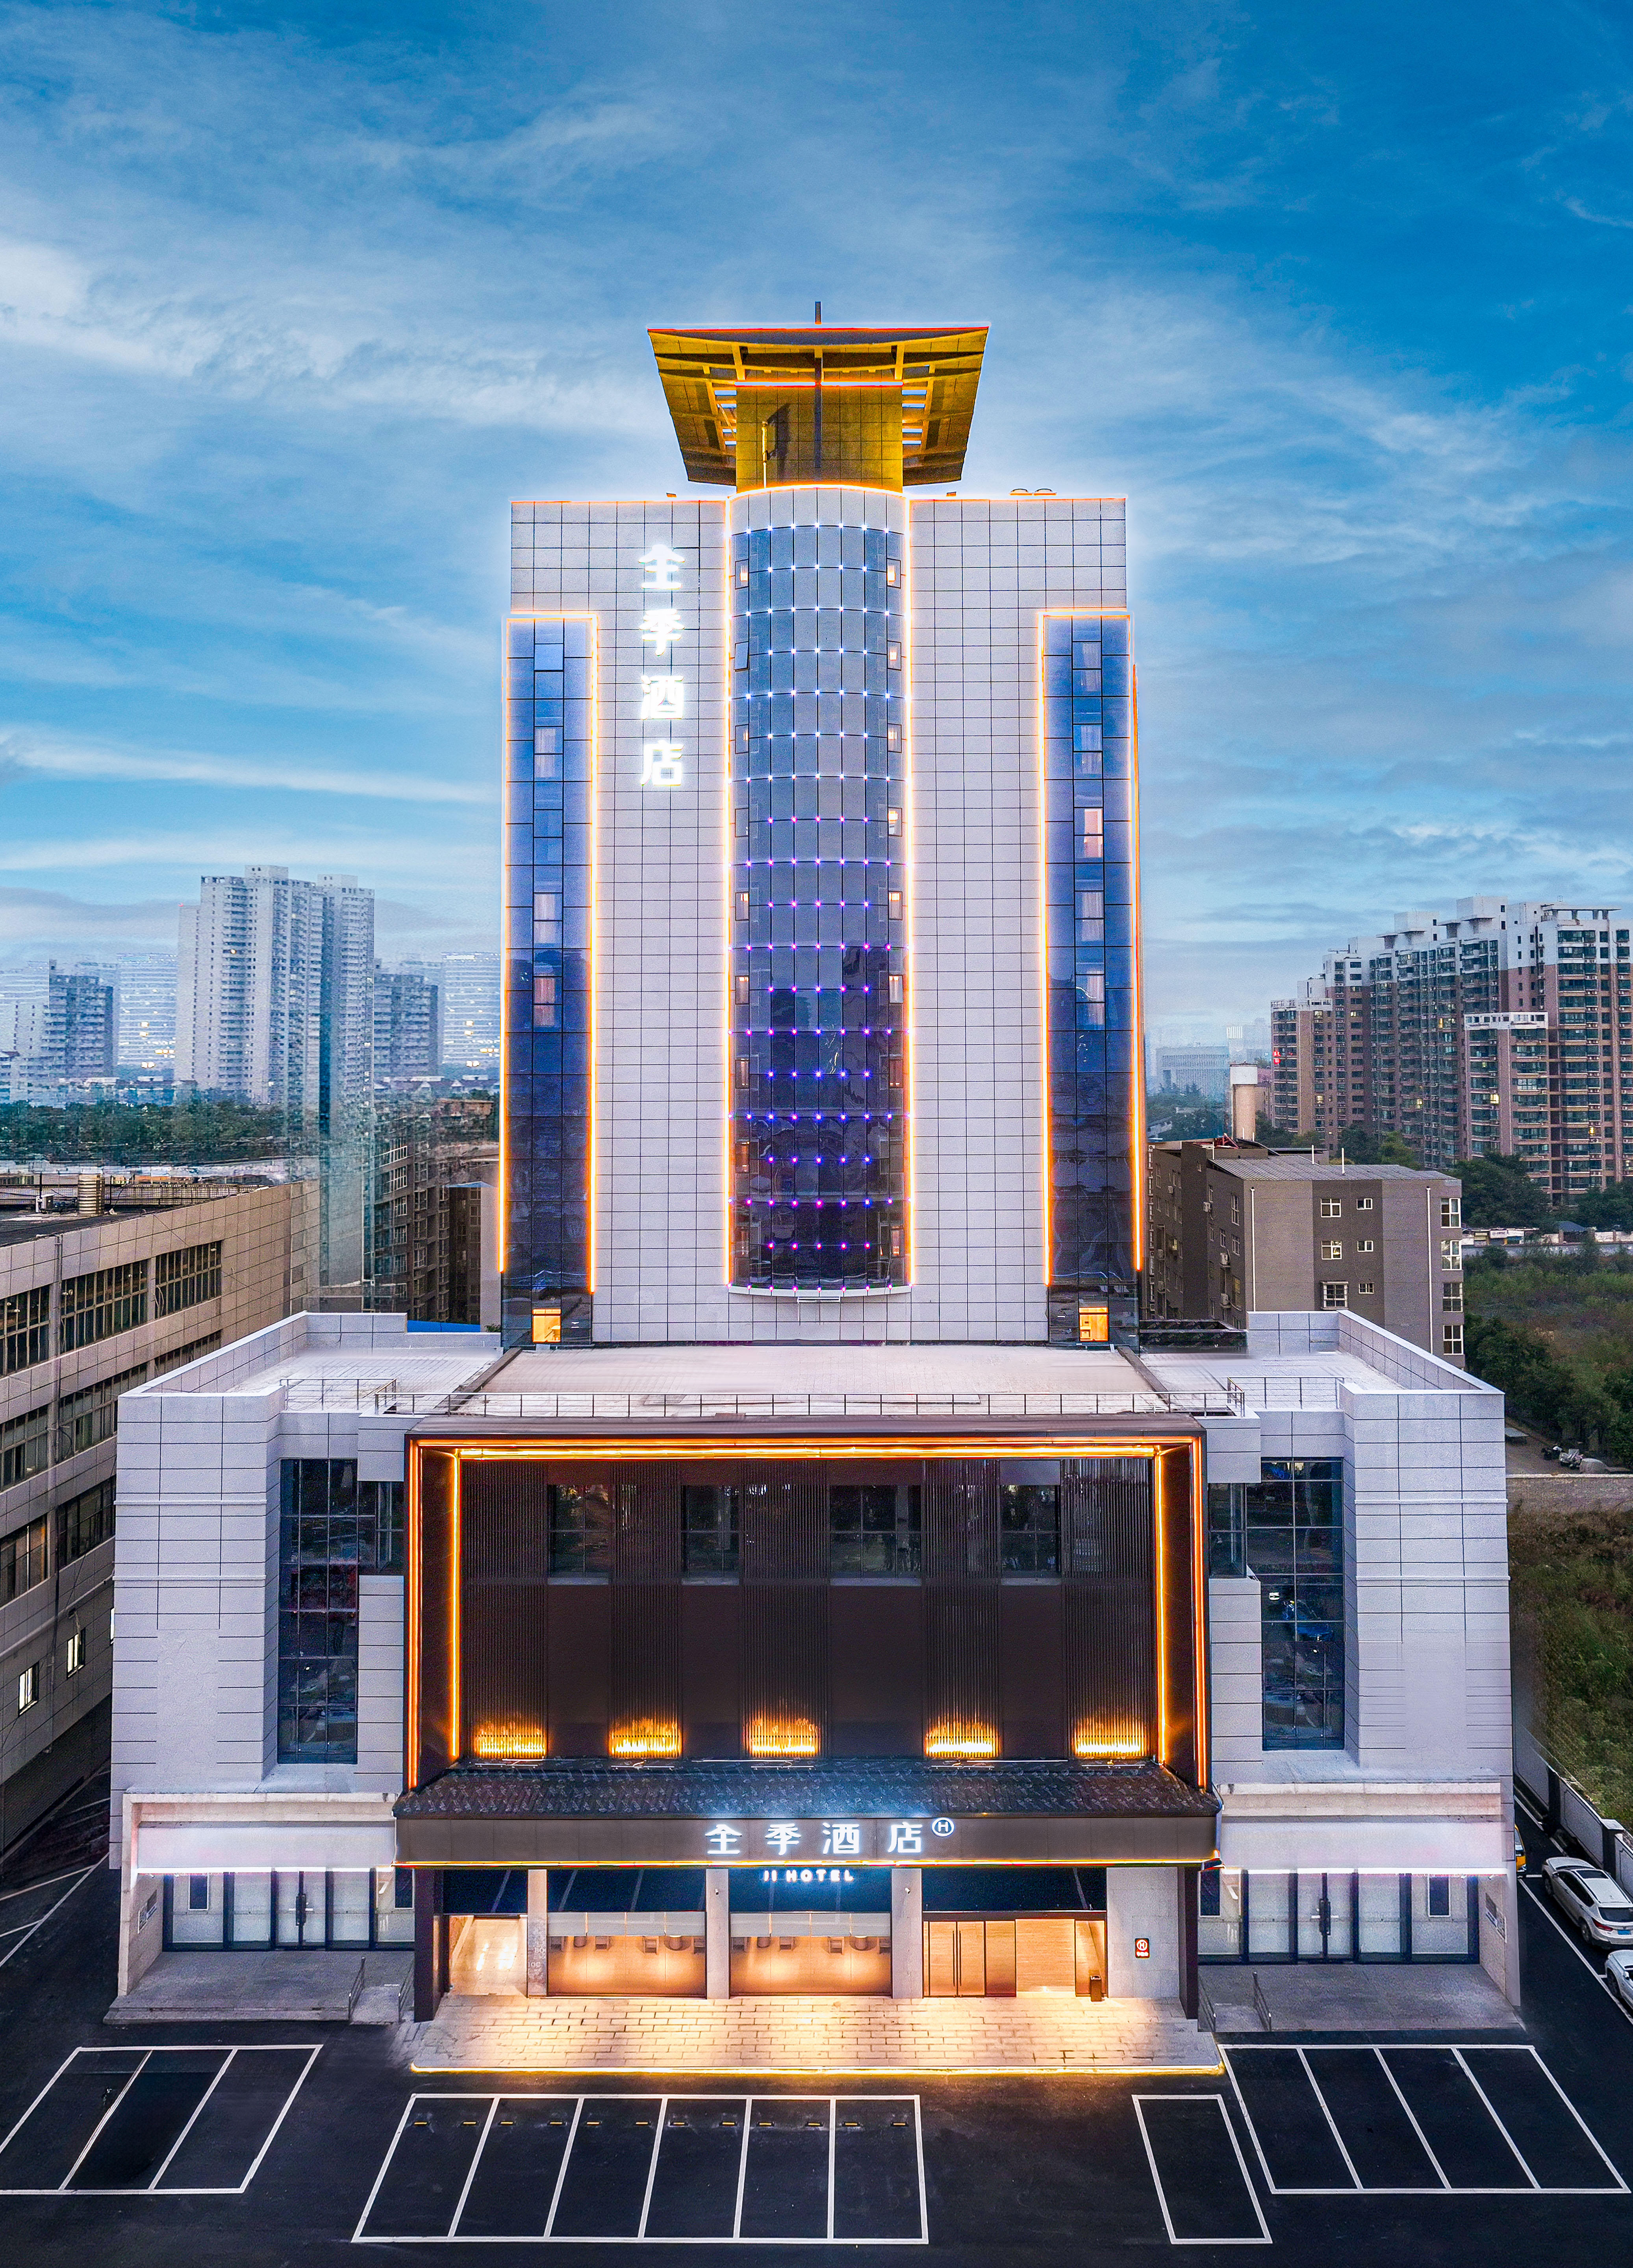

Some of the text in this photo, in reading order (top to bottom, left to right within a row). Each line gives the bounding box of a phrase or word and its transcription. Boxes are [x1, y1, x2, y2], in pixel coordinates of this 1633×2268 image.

[638, 544, 685, 786] 全季酒店
[704, 1821, 923, 1856] 全季酒店
[786, 1870, 854, 1882] HOTEL
